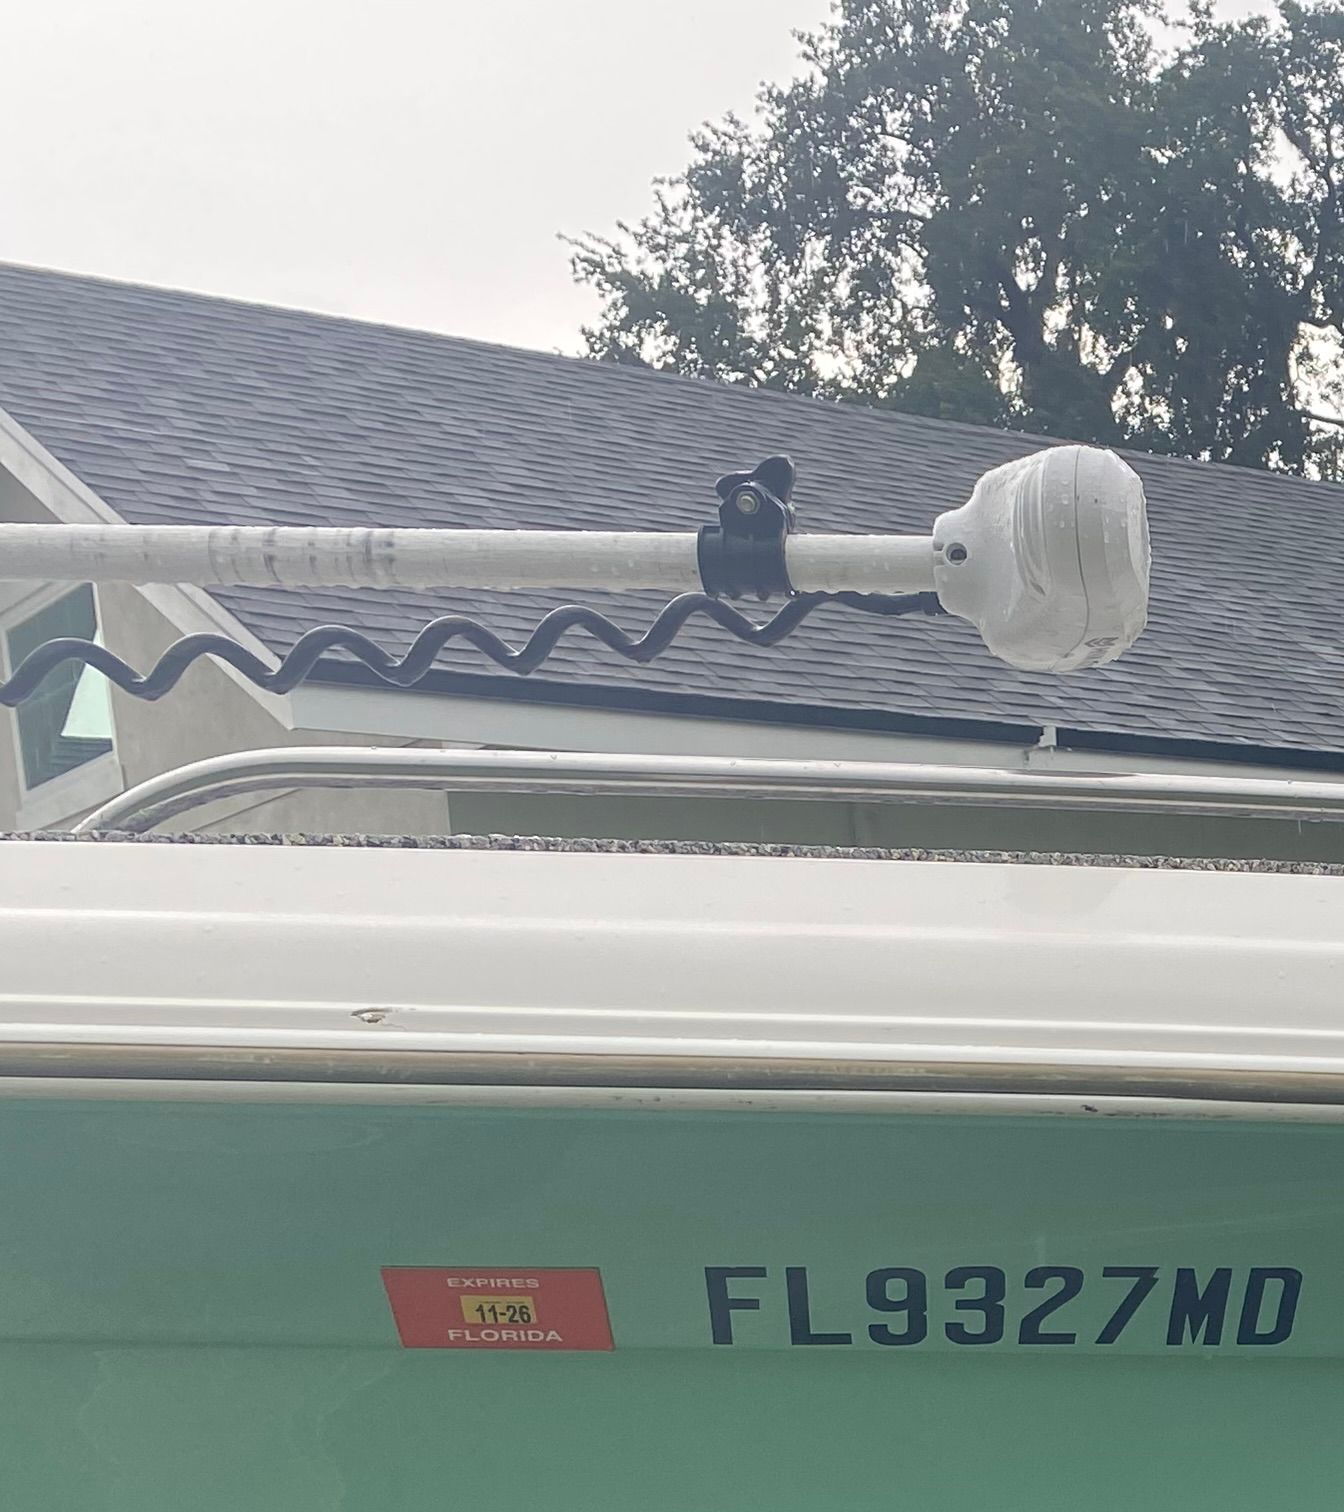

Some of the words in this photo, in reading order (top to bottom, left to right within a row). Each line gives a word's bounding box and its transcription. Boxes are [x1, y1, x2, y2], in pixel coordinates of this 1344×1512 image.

[446, 1277, 540, 1288] EXPIRES
[475, 1303, 532, 1324] 11-26
[704, 1265, 1303, 1346] FL9327MD
[447, 1329, 563, 1342] FLORIDA
